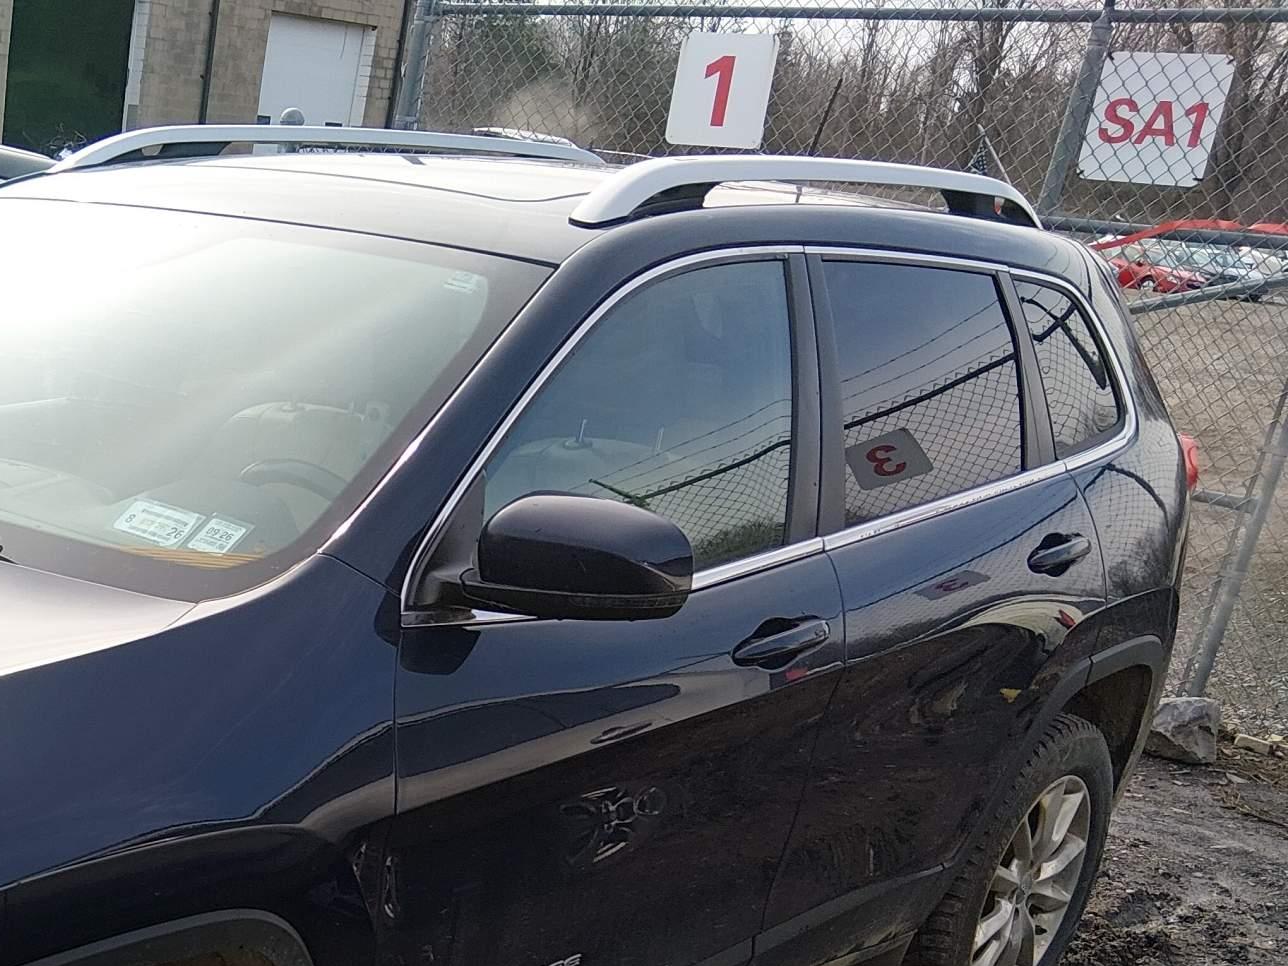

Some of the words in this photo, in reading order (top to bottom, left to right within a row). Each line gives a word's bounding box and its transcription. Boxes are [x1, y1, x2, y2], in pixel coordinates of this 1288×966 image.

[704, 54, 737, 128] 1
[1098, 98, 1210, 148] SA1
[166, 527, 184, 539] 26
[219, 531, 234, 541] 26
